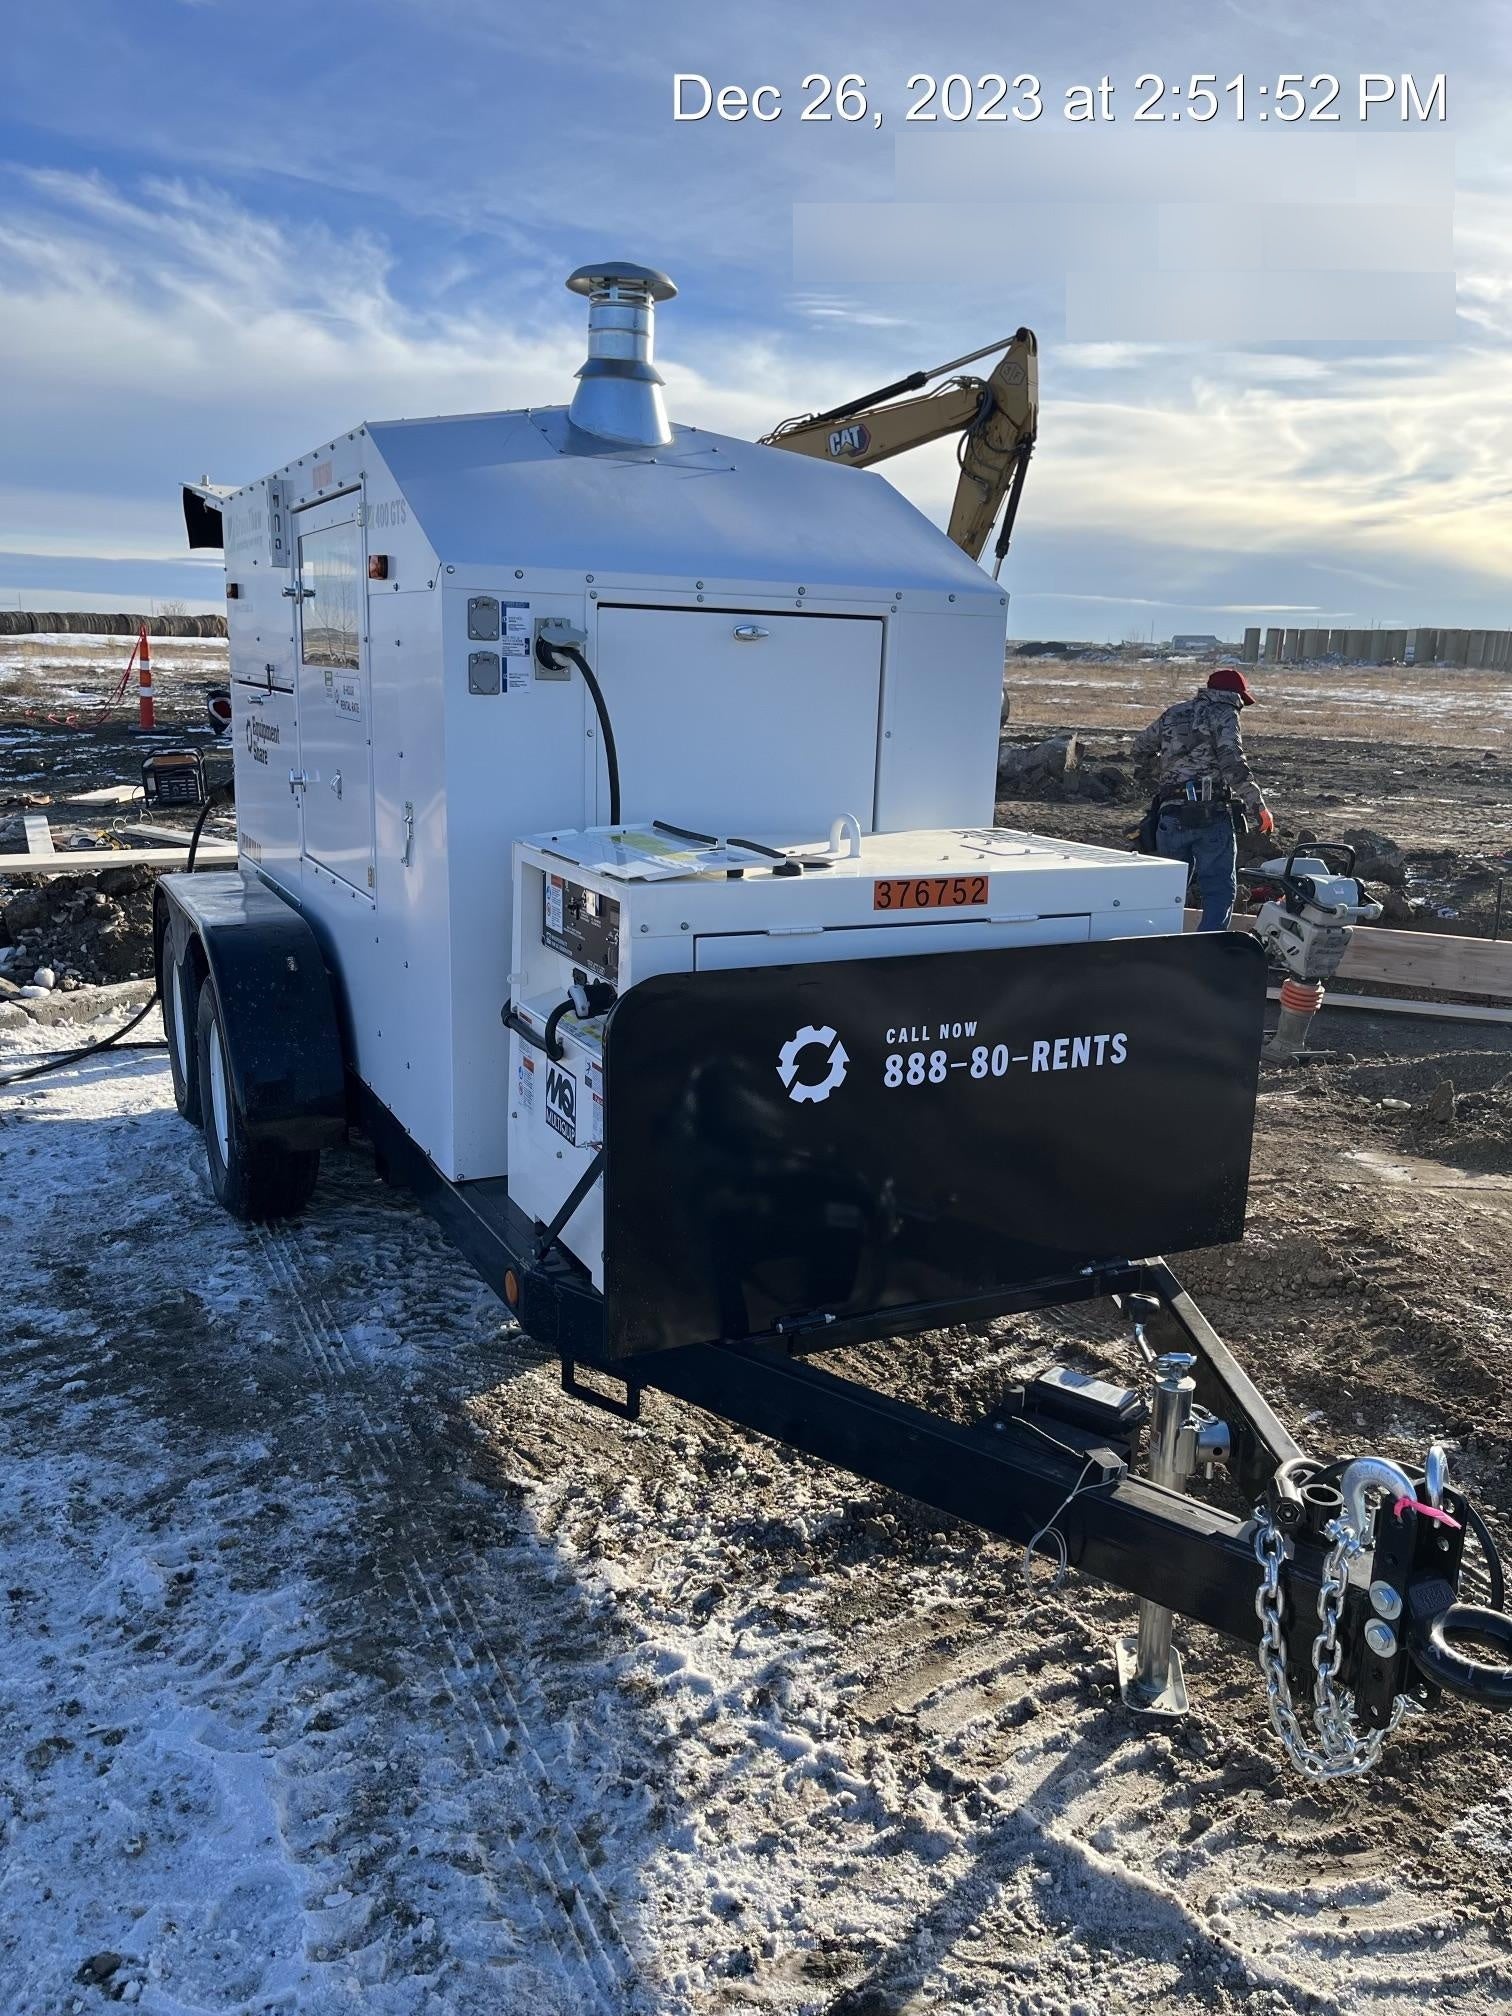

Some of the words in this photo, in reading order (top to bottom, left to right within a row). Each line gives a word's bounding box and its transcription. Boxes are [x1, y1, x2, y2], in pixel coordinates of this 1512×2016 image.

[829, 425, 861, 456] CAT
[252, 716, 280, 744] Equipment
[877, 878, 985, 909] 376752
[886, 1025, 930, 1044] CALL
[939, 1021, 978, 1040] NOW
[883, 1032, 1128, 1088] 888-80-RENTS
